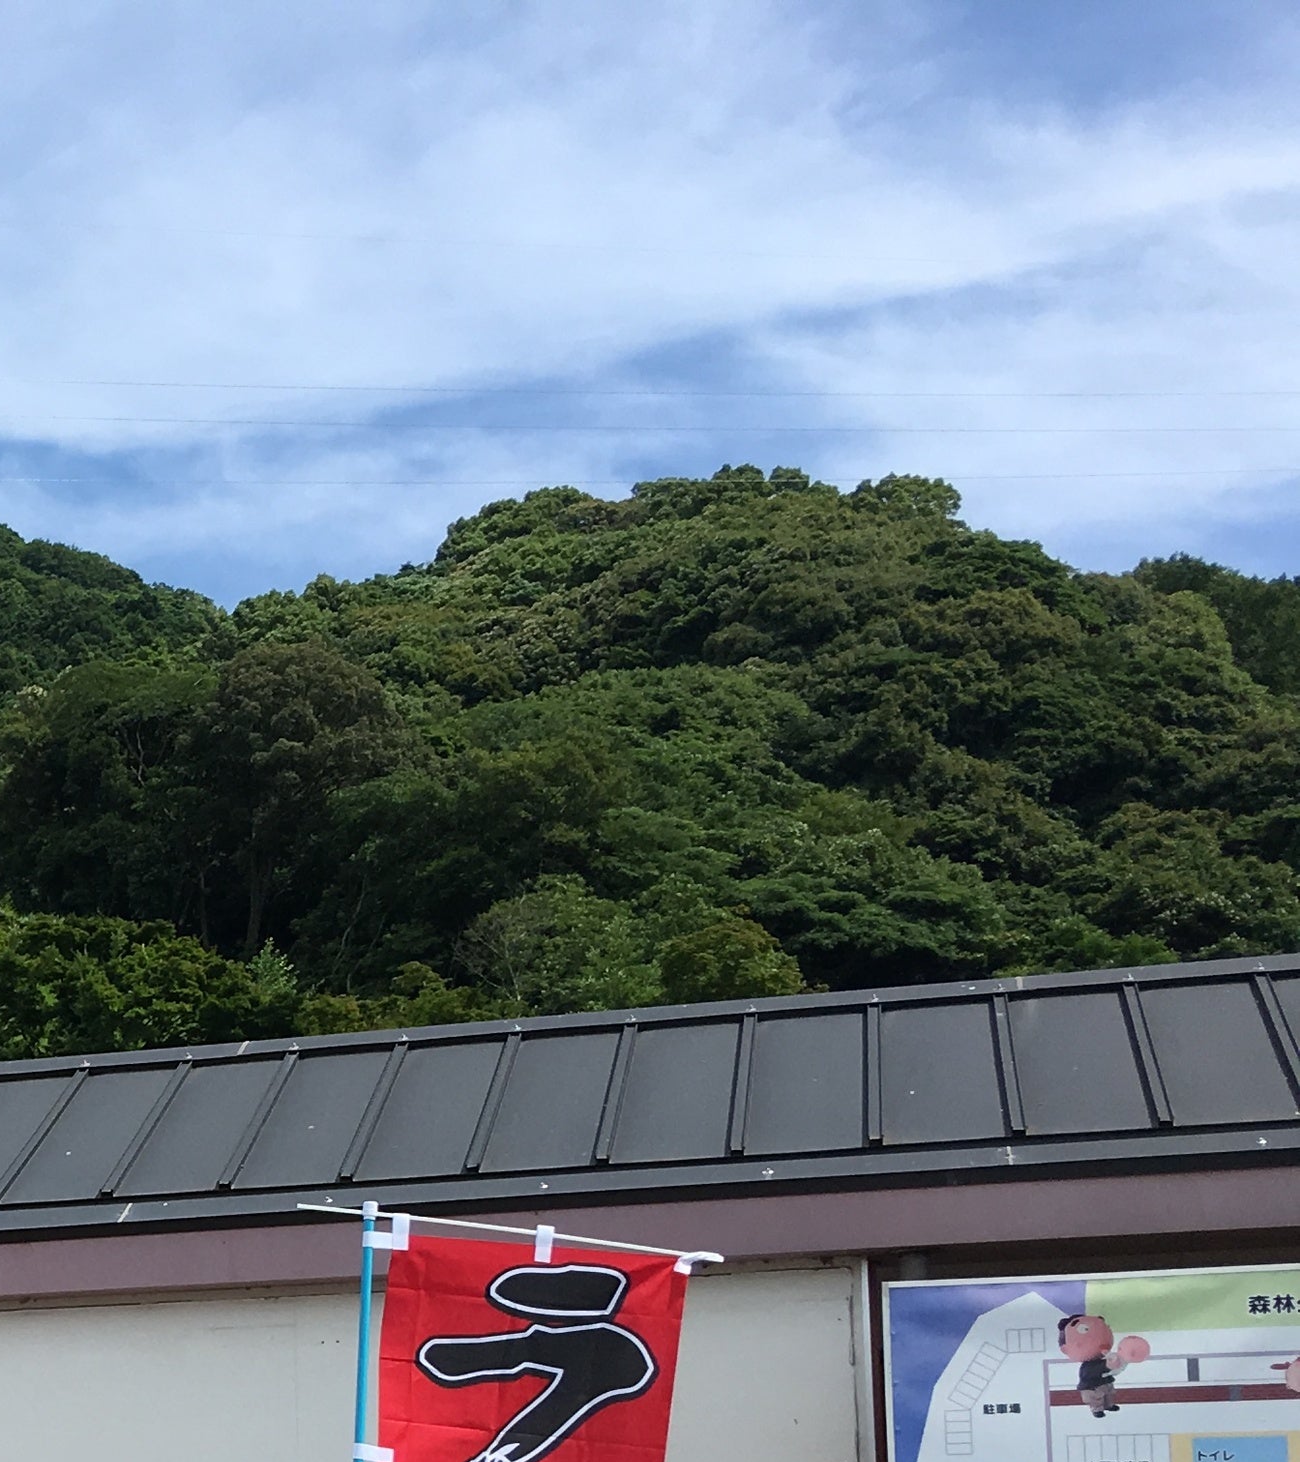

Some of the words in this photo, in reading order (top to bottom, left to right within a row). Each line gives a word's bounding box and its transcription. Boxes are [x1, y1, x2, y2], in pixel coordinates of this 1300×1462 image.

[1248, 1293, 1300, 1315] 森林
[982, 1402, 1022, 1415] 駐車場
[1196, 1450, 1235, 1462] トイレ
